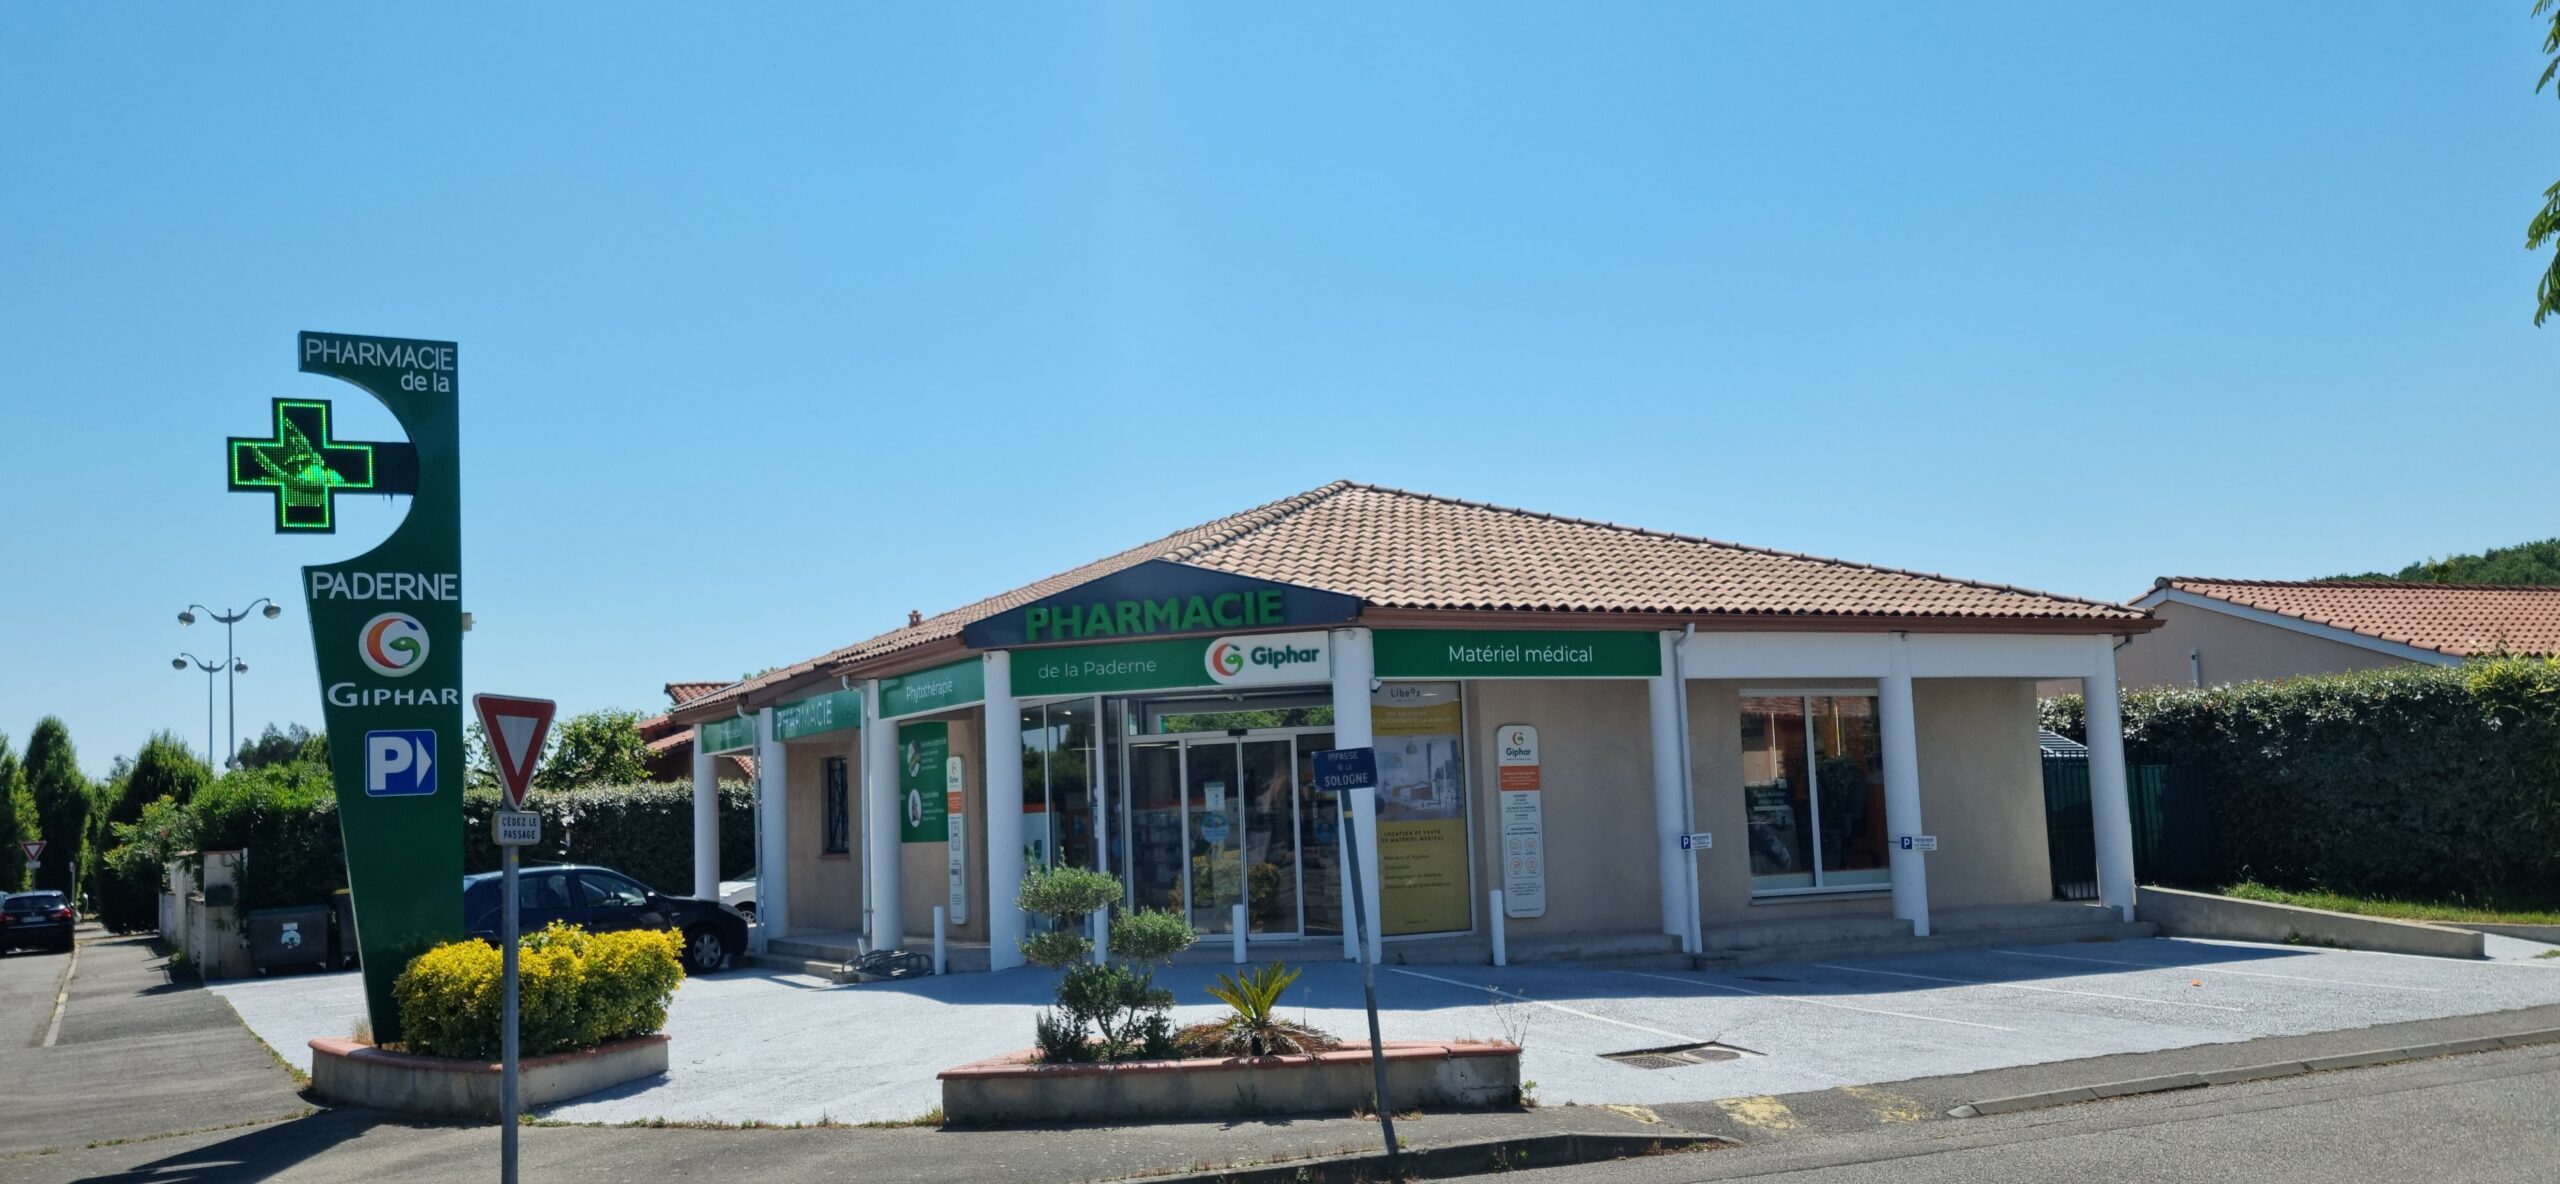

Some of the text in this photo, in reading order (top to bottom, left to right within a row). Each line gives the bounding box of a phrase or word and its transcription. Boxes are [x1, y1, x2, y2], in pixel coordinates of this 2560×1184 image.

[306, 338, 454, 371] PHARMACIE
[400, 370, 450, 393] de la
[312, 571, 459, 601] PADERNE
[1025, 589, 1285, 641] PHARMACIE
[1250, 644, 1320, 669] Giphar
[1449, 644, 1593, 663] Matériel médical
[1038, 658, 1157, 679] de la Paderne
[906, 677, 953, 704] Phytothérapie
[776, 700, 833, 735] PHARMACIE
[1327, 751, 1360, 761] IMPASSE
[1505, 747, 1532, 758] Giphar
[369, 736, 414, 791] P
[1324, 772, 1369, 788] SOLOGNE
[502, 815, 537, 827] CÉDEZ LE
[503, 830, 536, 840] PASSAGE
[1683, 836, 1690, 849] P
[1903, 837, 1911, 849] P
